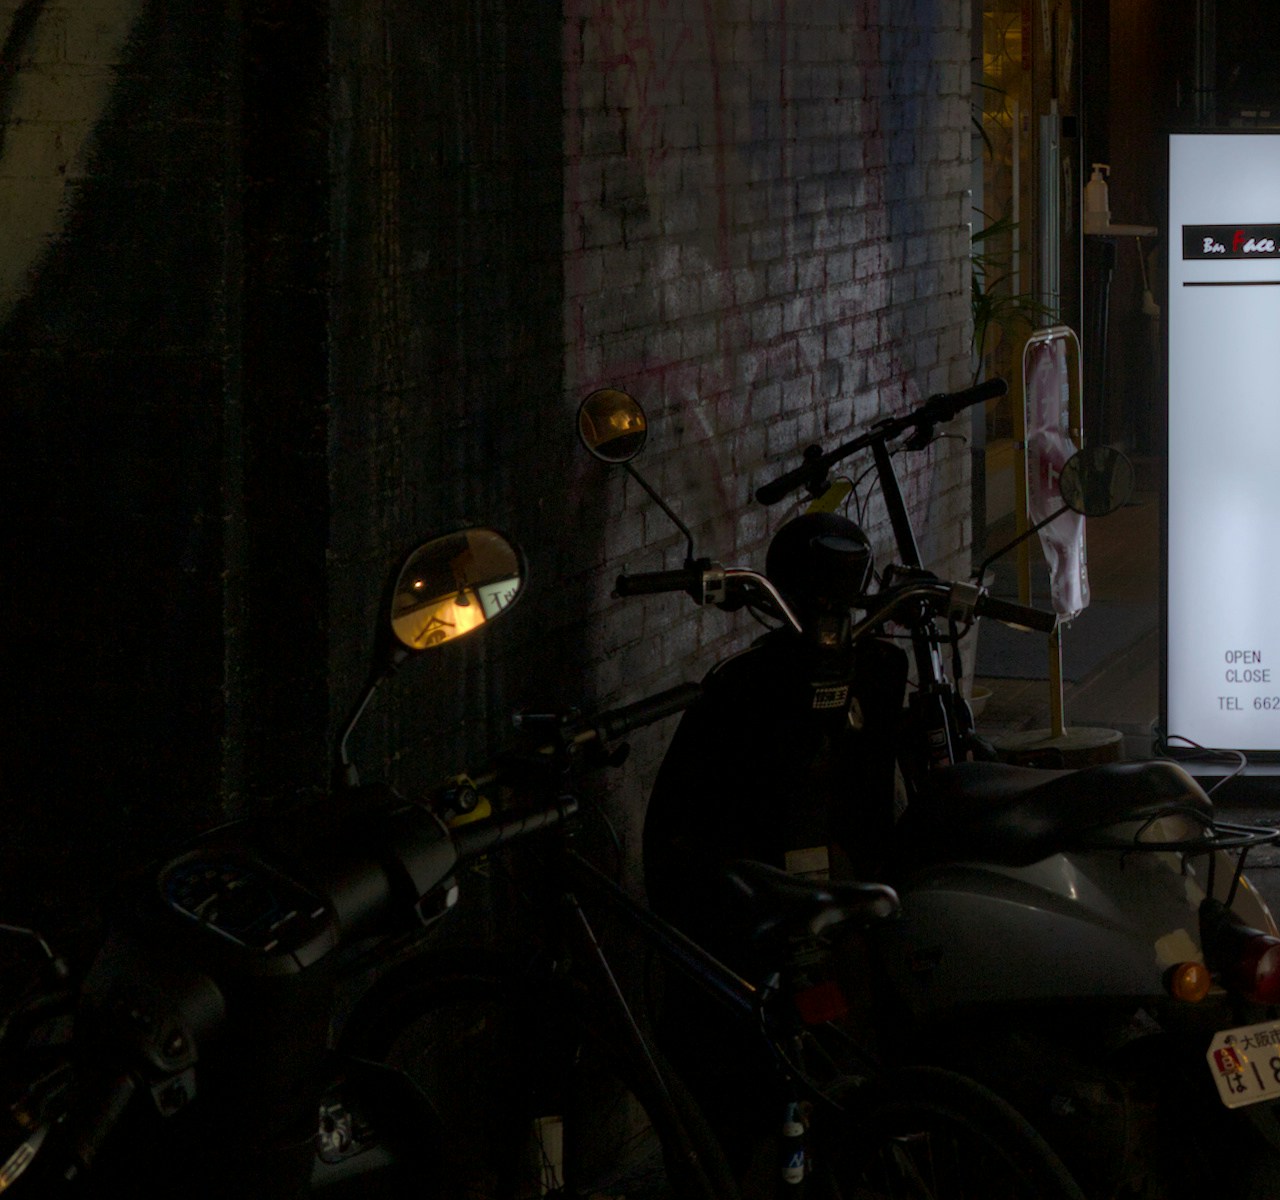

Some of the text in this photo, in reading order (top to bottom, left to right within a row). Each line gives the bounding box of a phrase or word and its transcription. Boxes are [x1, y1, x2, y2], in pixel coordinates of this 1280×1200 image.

[1232, 229, 1276, 254] Face
[1225, 649, 1262, 664] OPEN
[1225, 668, 1271, 683] CLOSE
[1217, 695, 1244, 711] TEL
[1220, 1073, 1247, 1095] は
